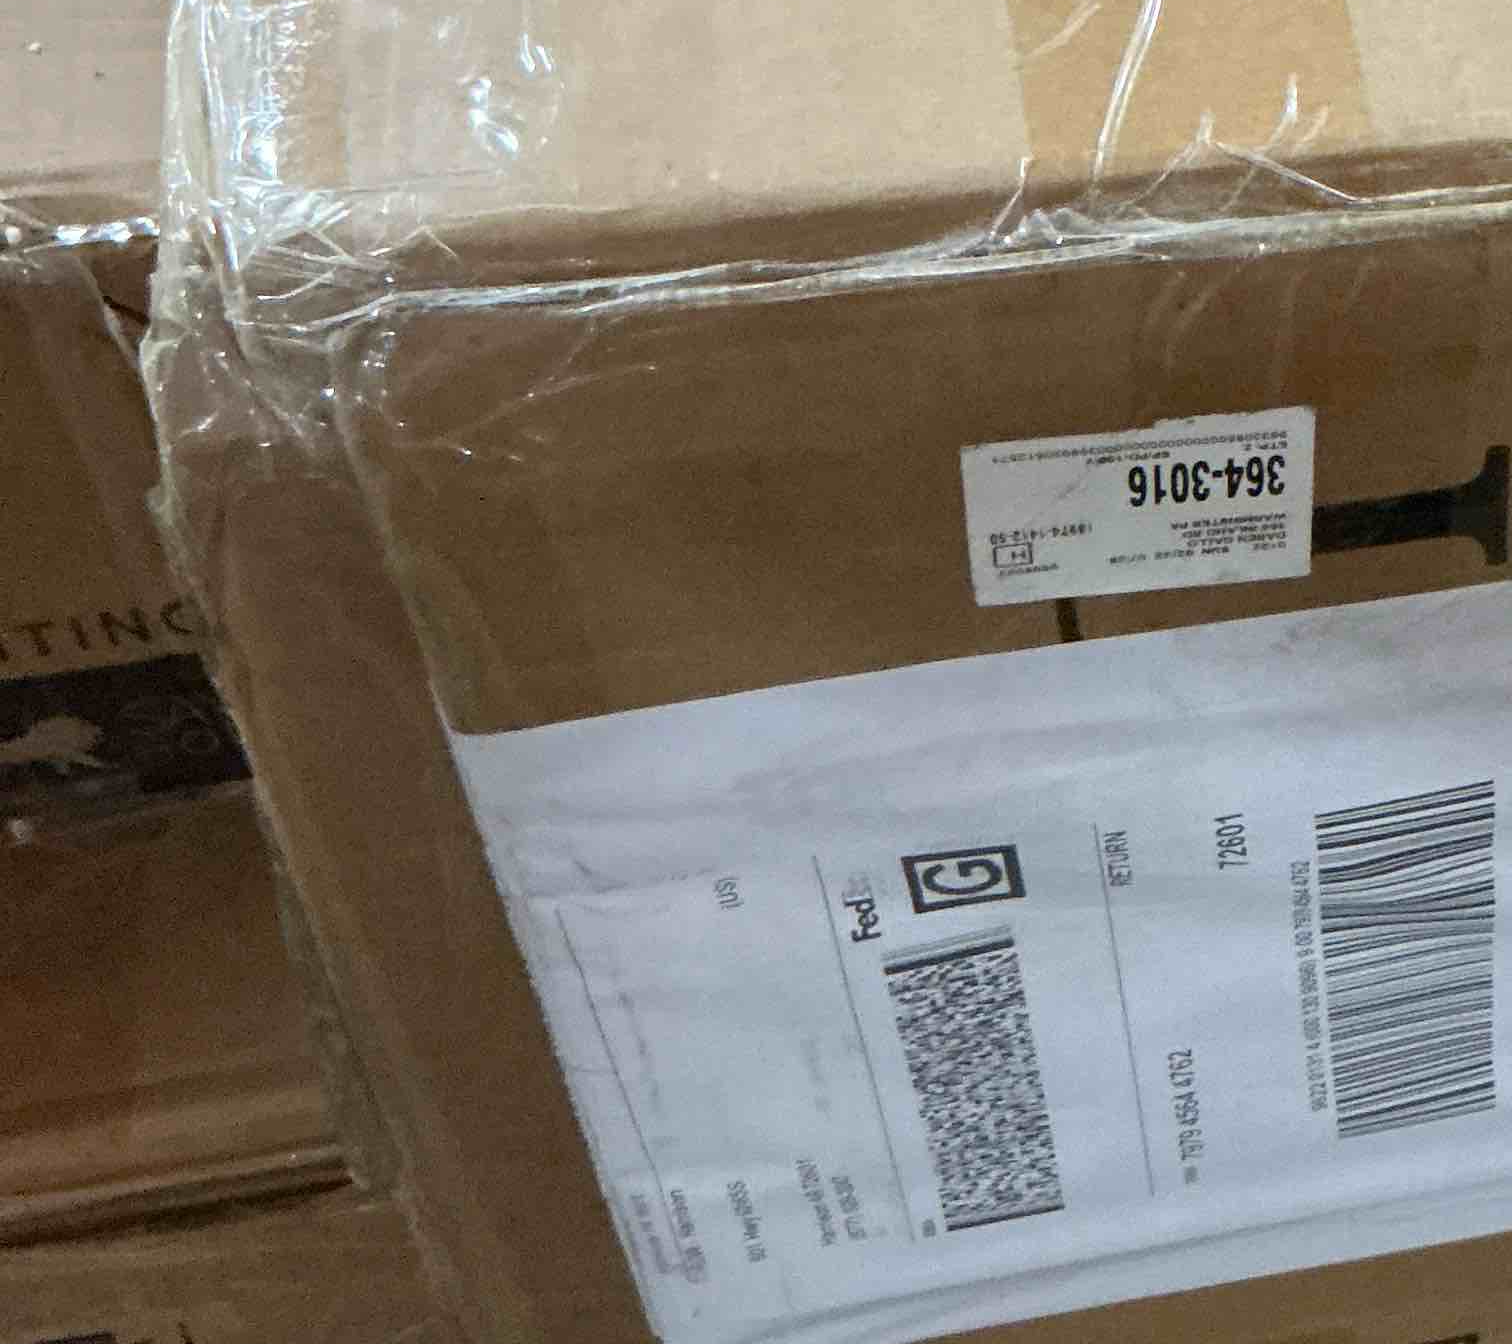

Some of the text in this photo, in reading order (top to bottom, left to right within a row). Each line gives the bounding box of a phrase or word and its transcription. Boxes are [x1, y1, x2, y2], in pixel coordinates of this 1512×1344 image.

[1128, 455, 1287, 508] 364-3016
[1103, 829, 1134, 887] RETURN
[1213, 812, 1249, 870] 72601
[922, 857, 1006, 898] G
